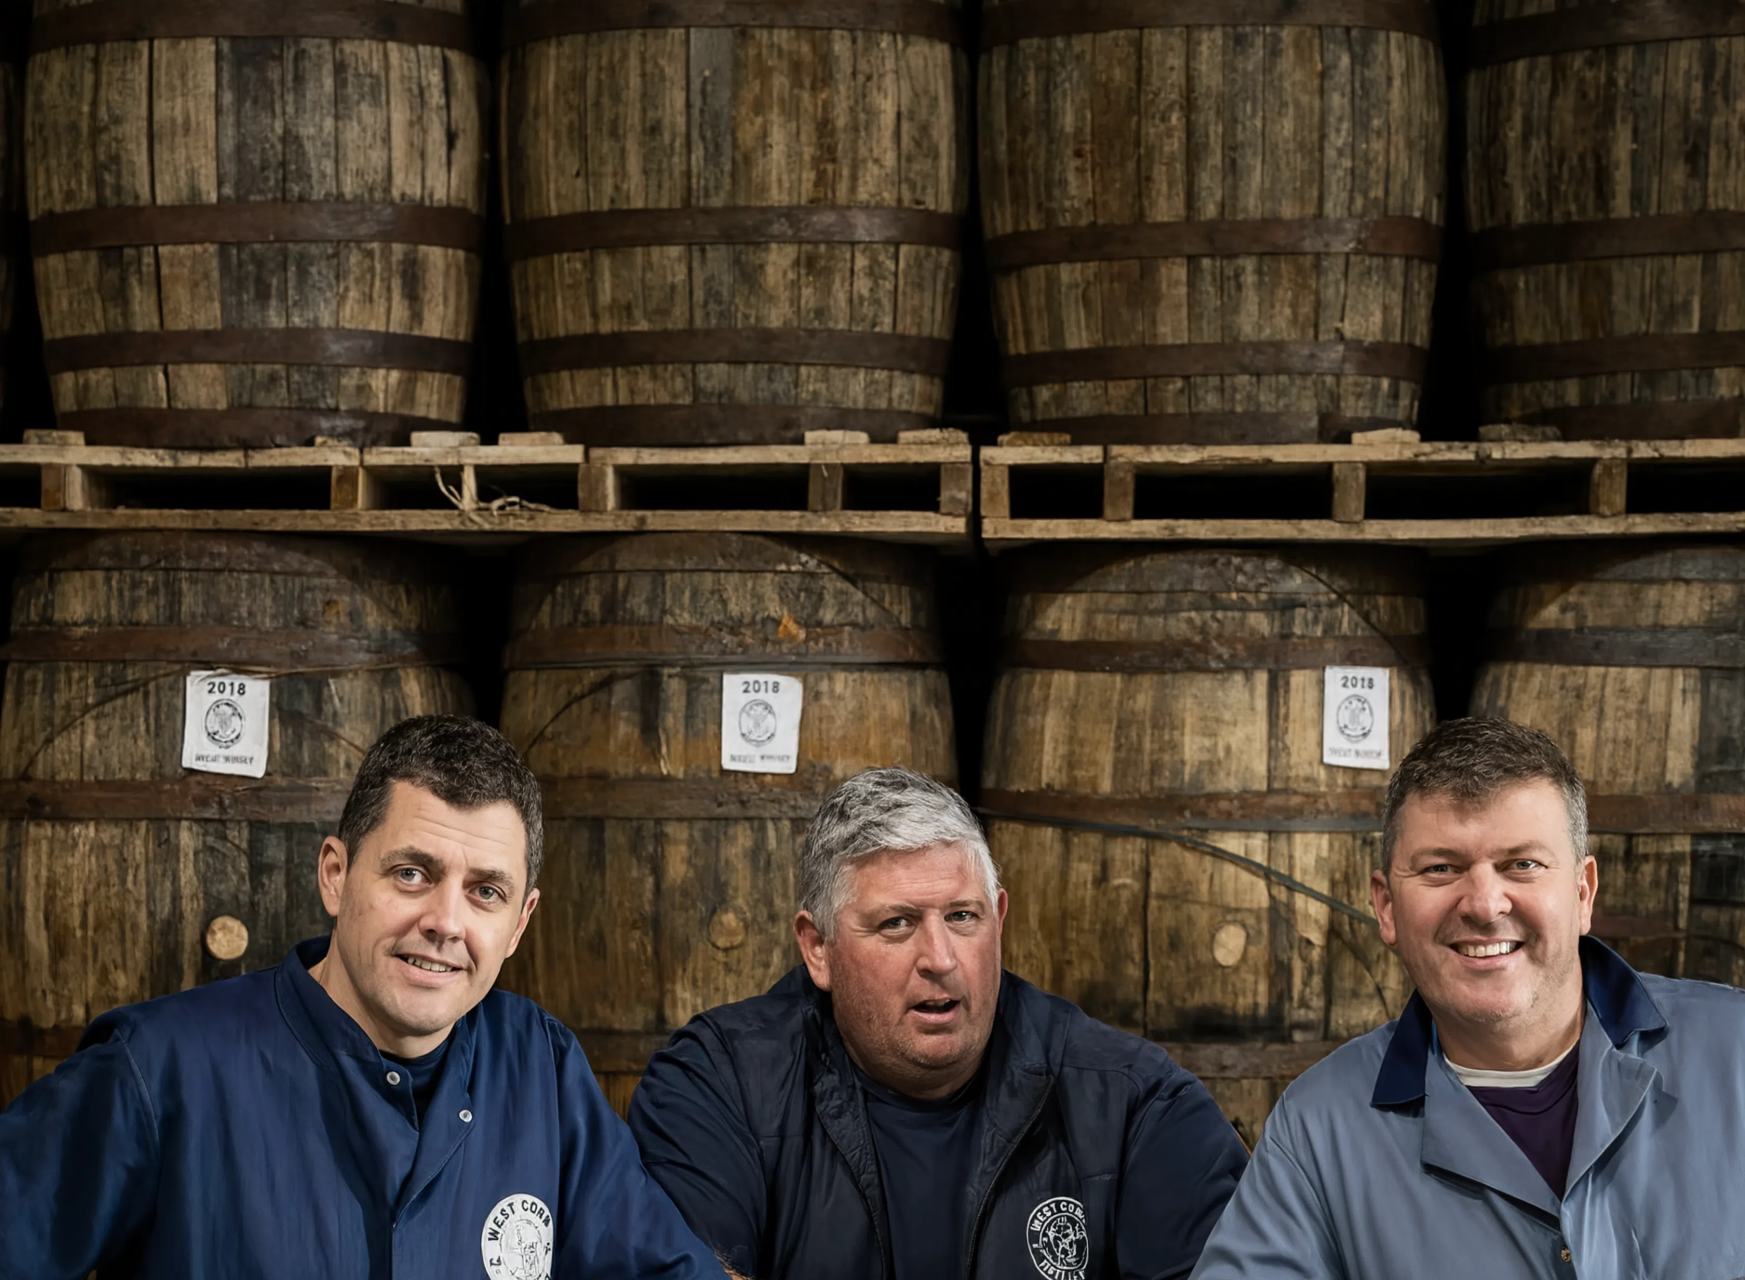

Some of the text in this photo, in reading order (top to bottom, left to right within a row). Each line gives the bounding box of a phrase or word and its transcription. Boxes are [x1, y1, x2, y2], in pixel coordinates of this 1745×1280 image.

[207, 681, 246, 696] 2018
[742, 680, 780, 694] 2018
[1340, 675, 1374, 690] 2018
[487, 1201, 515, 1242] WEST
[1030, 1201, 1086, 1232] WEST CO
